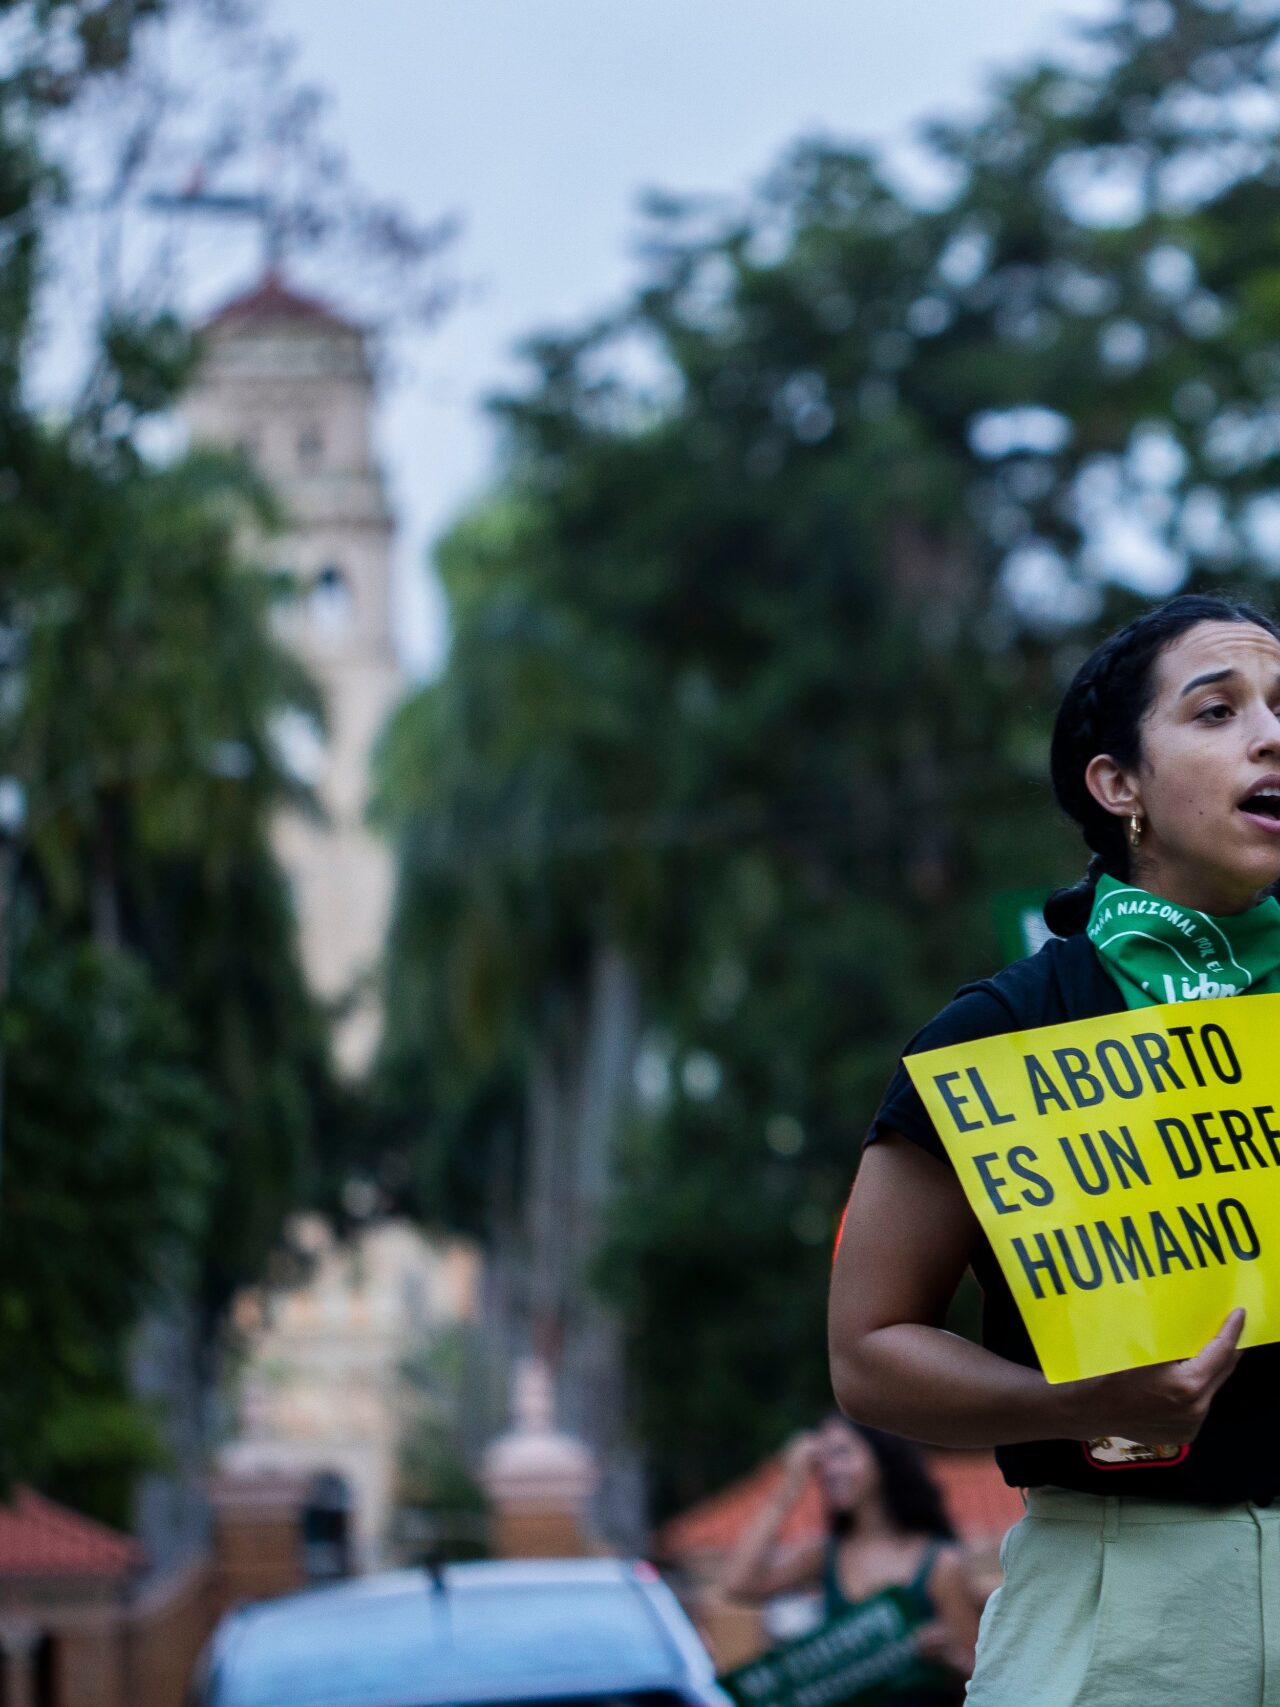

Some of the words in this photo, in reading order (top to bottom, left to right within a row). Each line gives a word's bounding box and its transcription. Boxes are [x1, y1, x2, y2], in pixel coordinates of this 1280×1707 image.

[1117, 900, 1198, 938] NACIONAL
[1162, 973, 1246, 1005] Libr
[931, 1066, 1015, 1133] EL
[1022, 1023, 1243, 1117] ABORTO
[971, 1145, 1055, 1215] ES
[1058, 1125, 1151, 1197] UN
[1010, 1197, 1262, 1300] HUMANO
